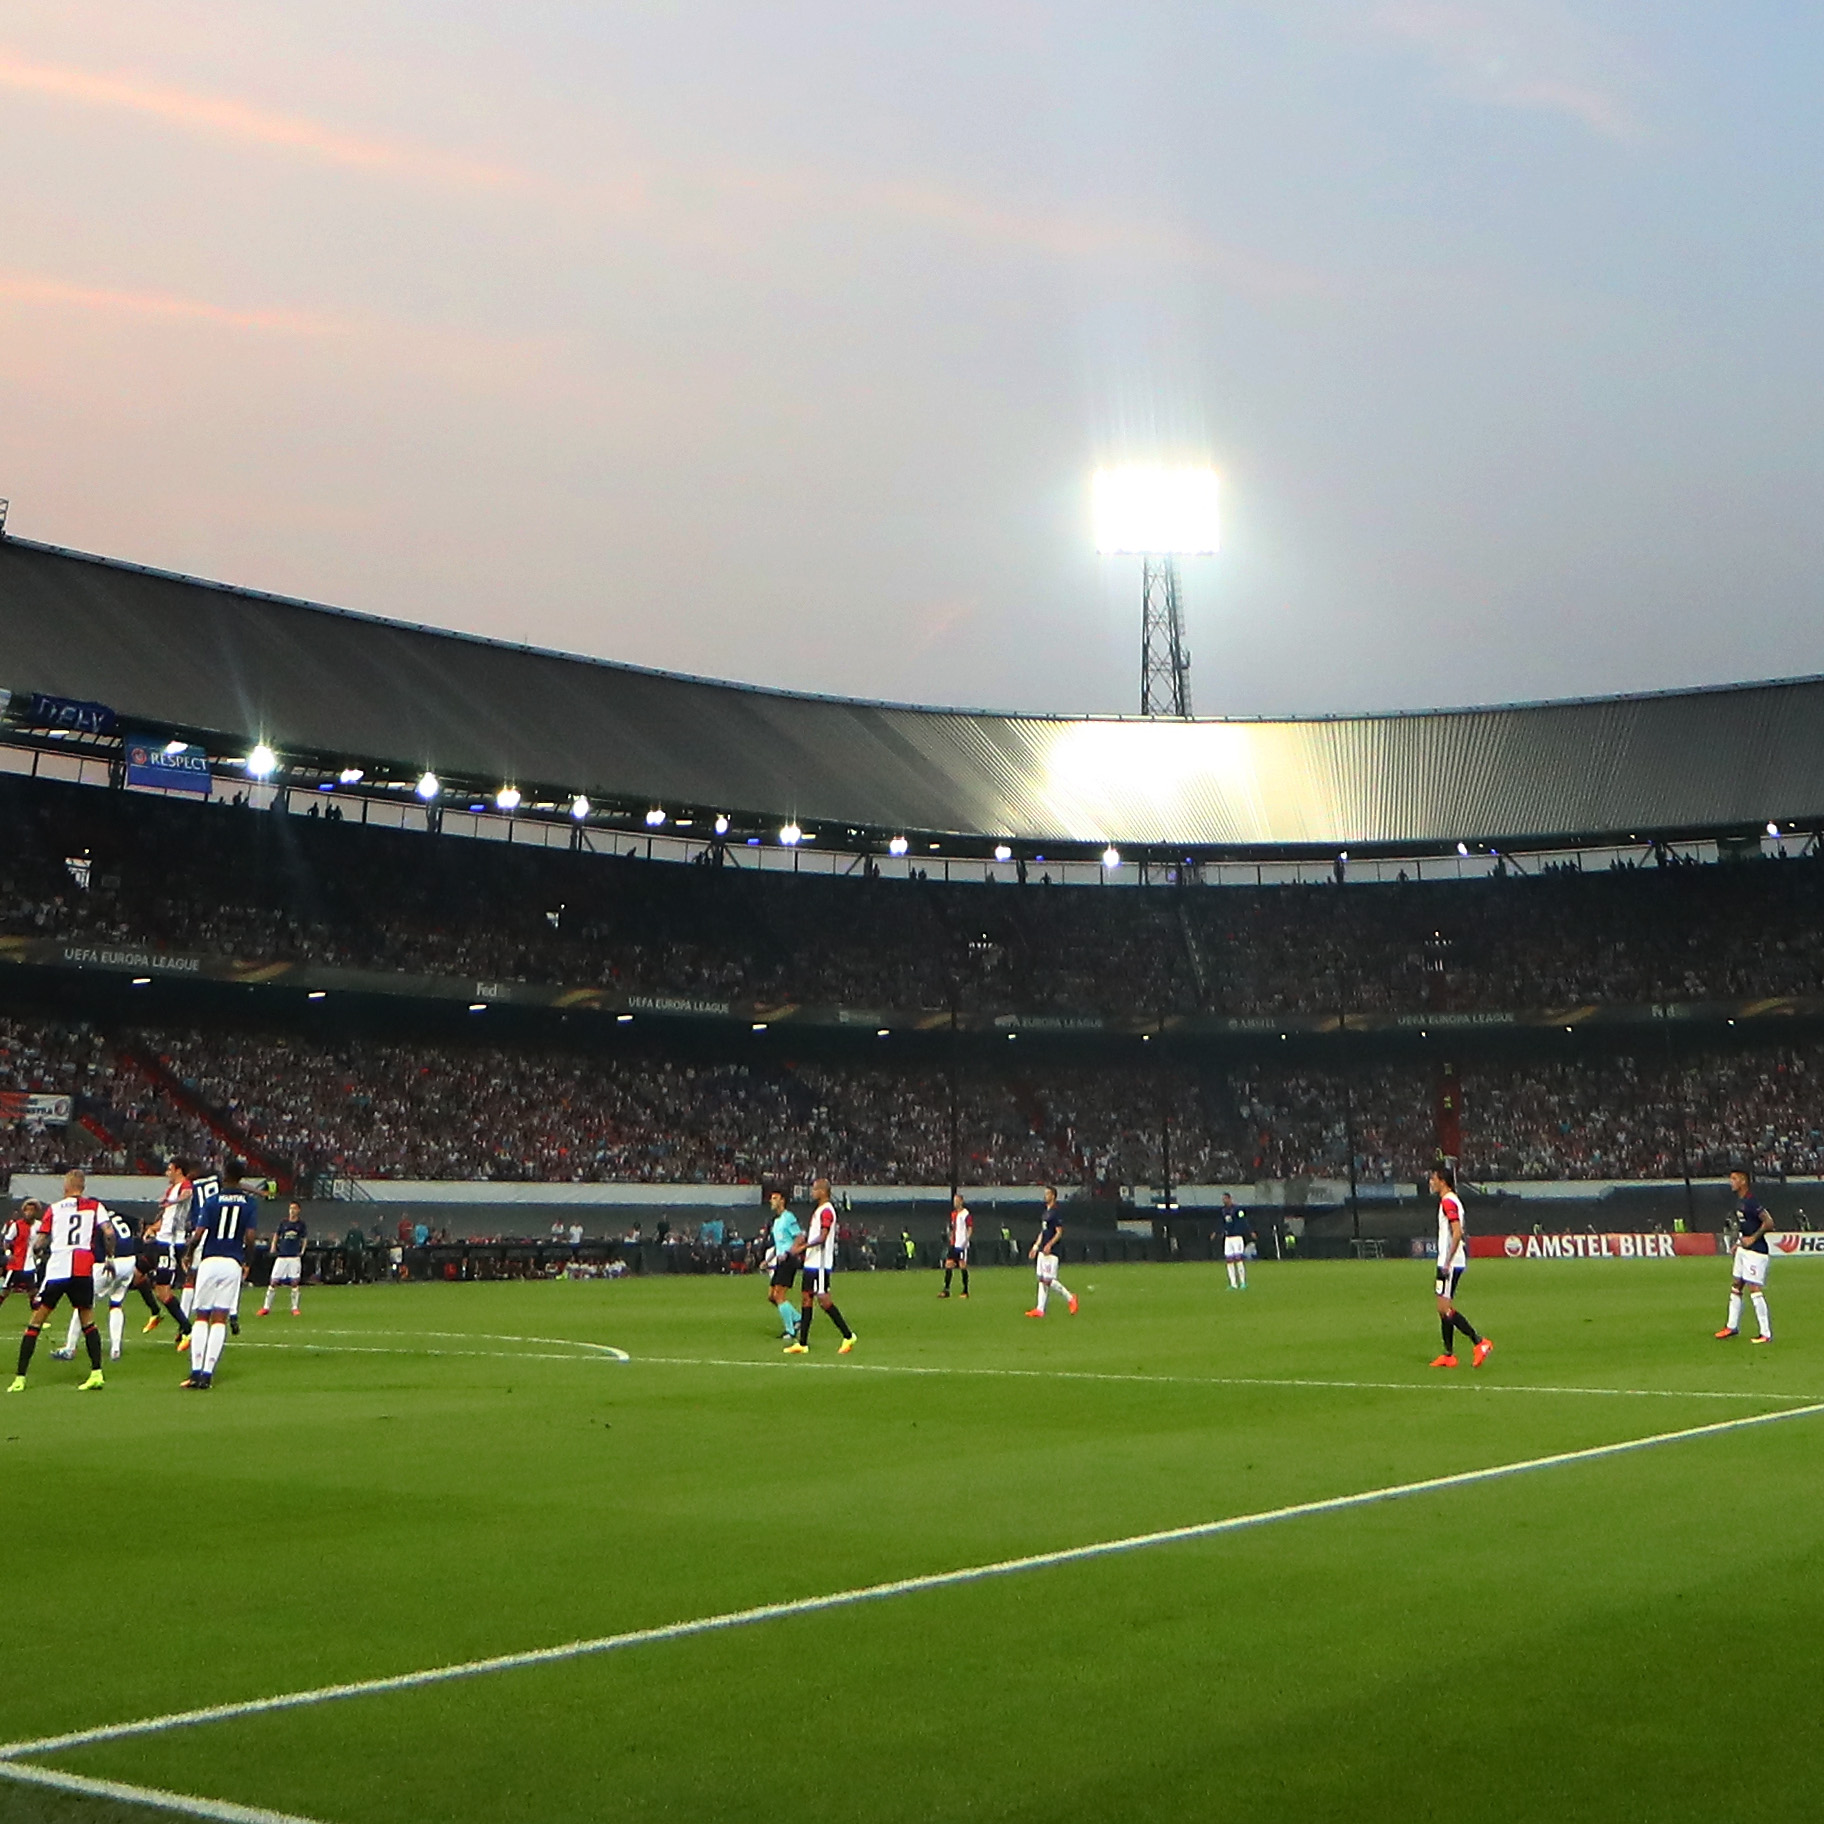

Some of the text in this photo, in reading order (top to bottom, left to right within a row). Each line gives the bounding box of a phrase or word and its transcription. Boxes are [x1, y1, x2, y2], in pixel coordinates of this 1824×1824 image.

[151, 752, 207, 772] RESPECT
[64, 947, 200, 972] UEFA EUROPA LEAGUE
[628, 996, 729, 1014] UEFA EUROPA LEAGUE
[68, 1214, 82, 1246] 2
[217, 1205, 240, 1240] 11
[1526, 1235, 1676, 1257] AMSTEL BIER
